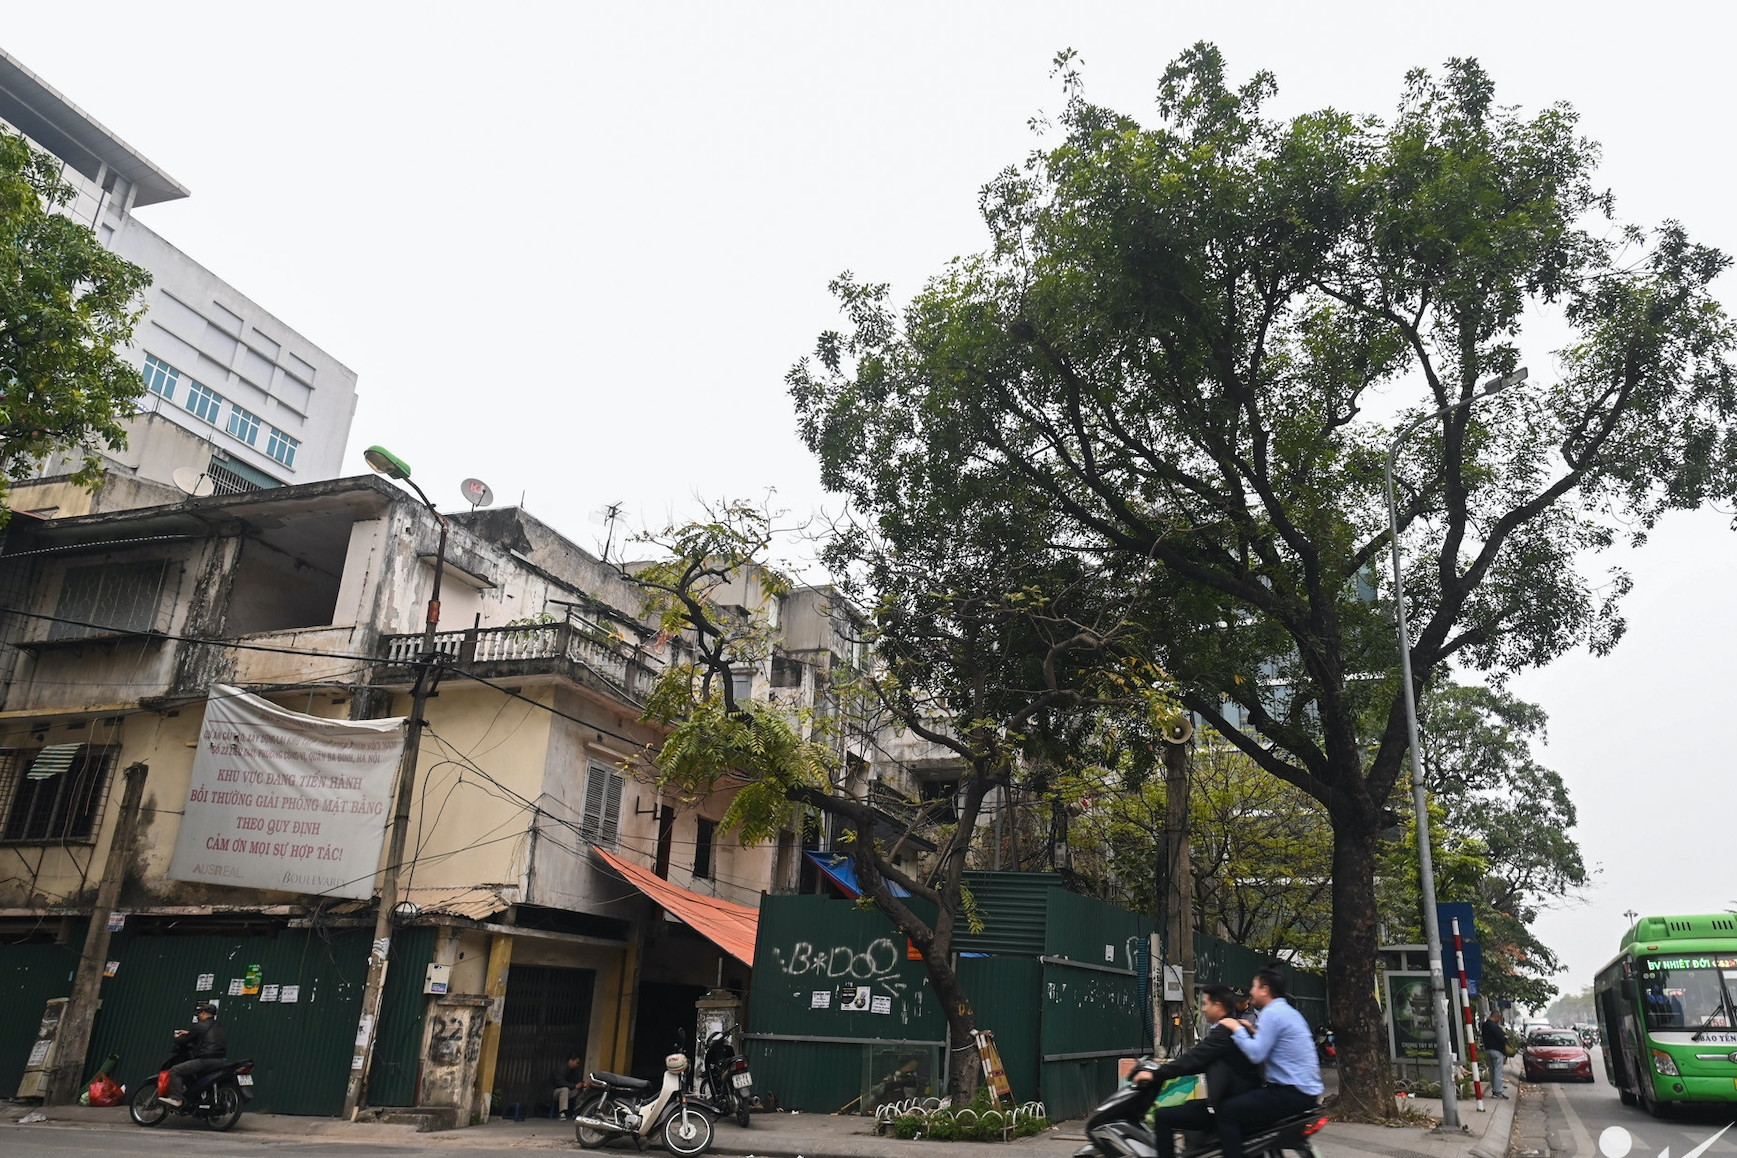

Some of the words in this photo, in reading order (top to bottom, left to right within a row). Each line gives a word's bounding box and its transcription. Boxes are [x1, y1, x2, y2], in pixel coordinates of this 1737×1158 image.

[217, 768, 240, 781] KHU
[243, 769, 264, 787] VỰC
[265, 773, 296, 787] ĐANG
[299, 770, 327, 790] TIẾN
[328, 773, 363, 790] HÀNH
[211, 790, 253, 807] THƯỜNG
[255, 791, 280, 809] GIẢI
[322, 797, 349, 816] MẶT
[236, 816, 265, 831] THEO
[266, 819, 290, 836] QUY
[292, 821, 321, 837] ĐỊNH
[206, 832, 230, 852] CẢM
[232, 837, 248, 853] ƠN
[249, 841, 271, 858] MỌI
[272, 842, 289, 860] SỰ
[290, 843, 314, 862] HỢP
[317, 843, 344, 861] TÁC!
